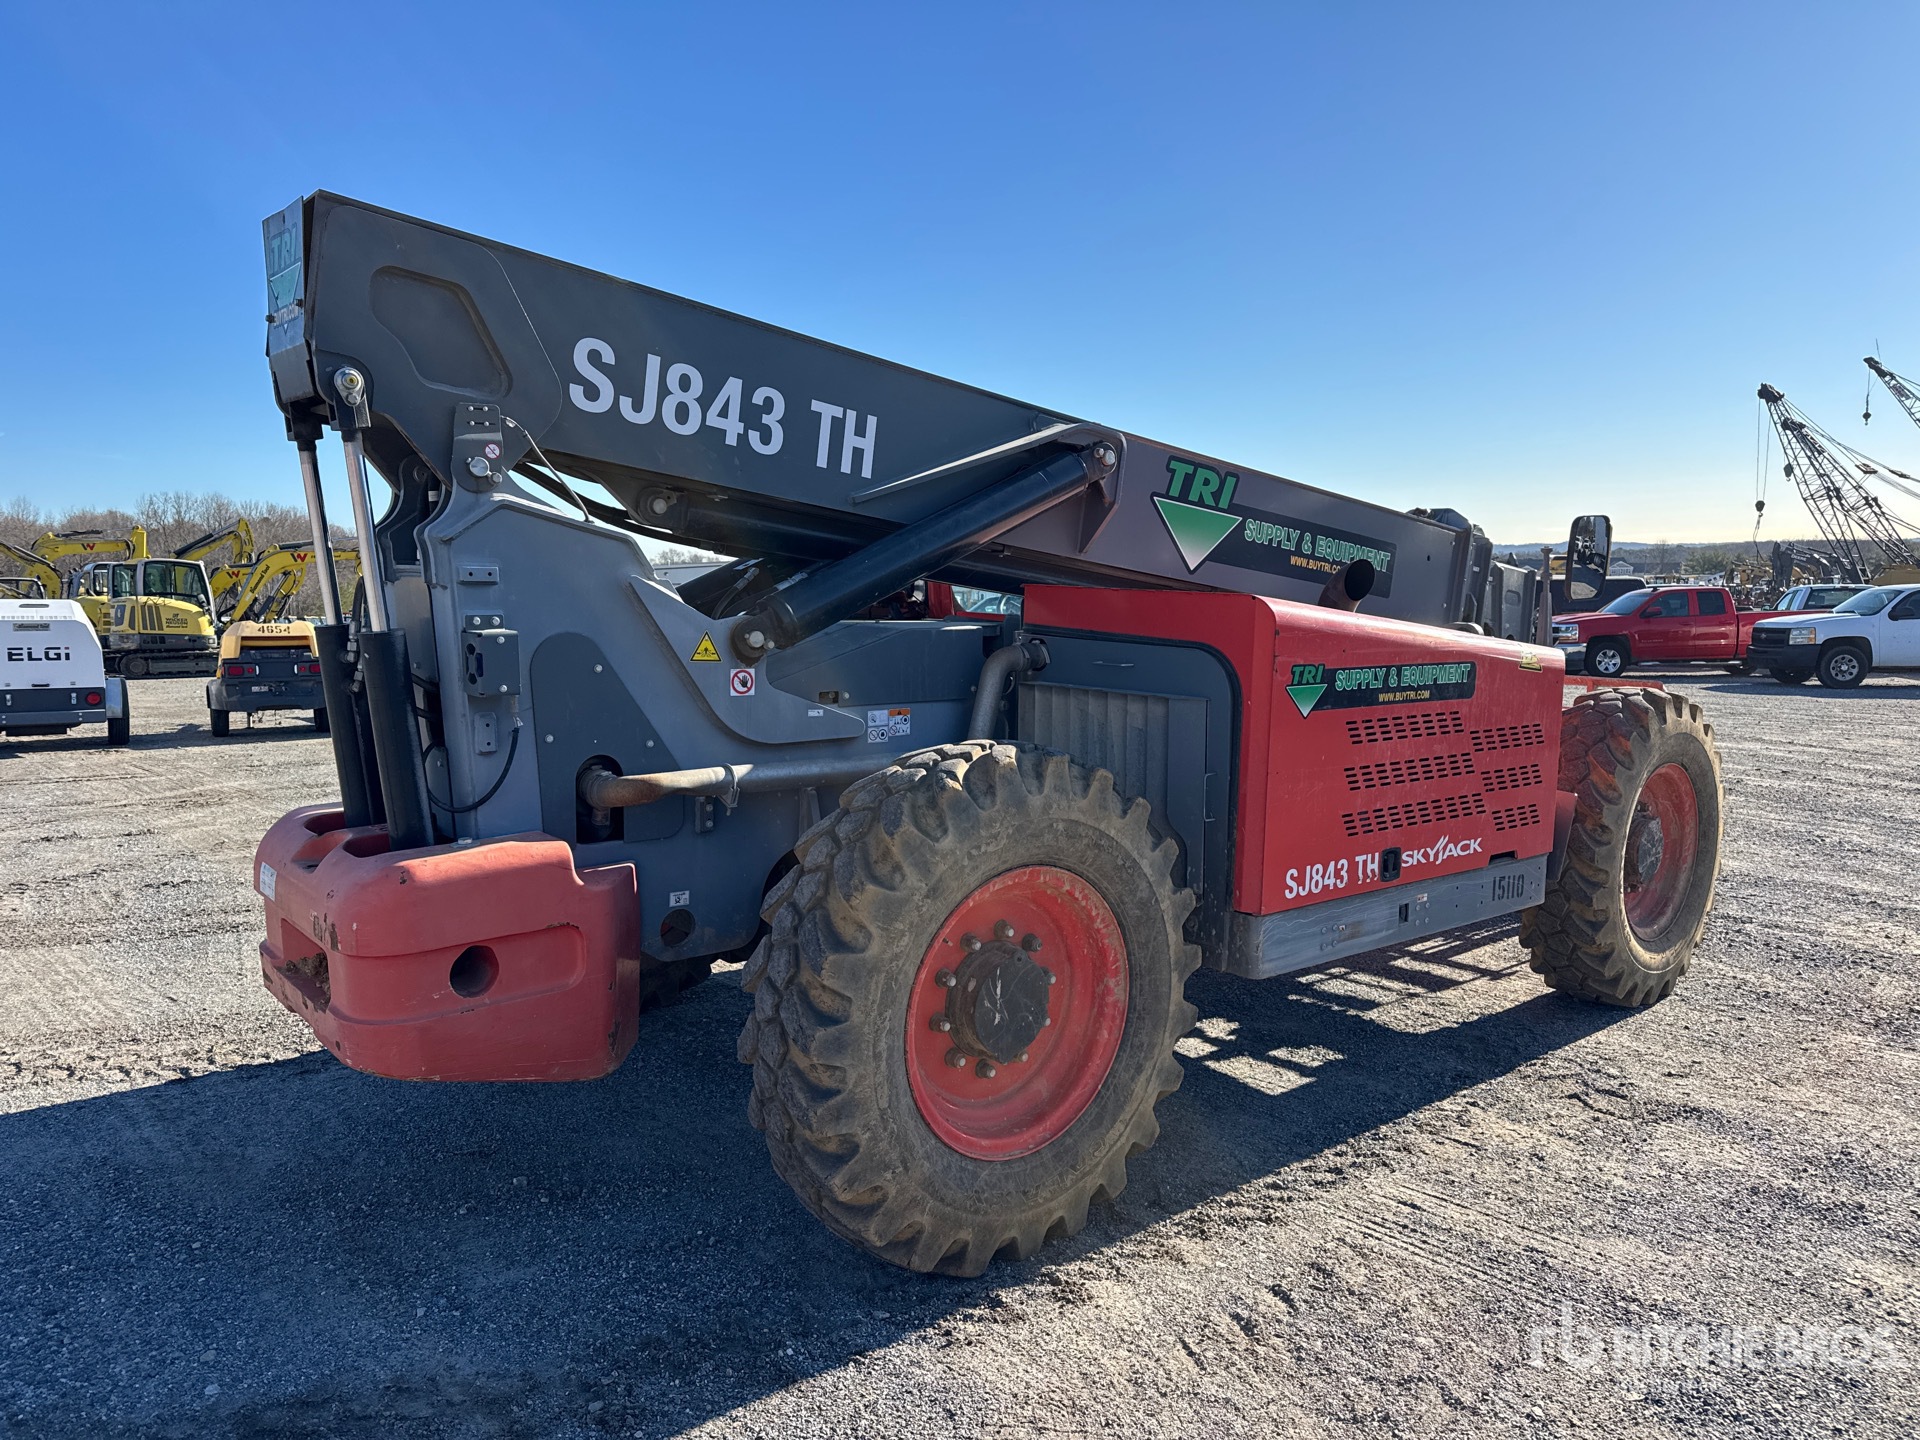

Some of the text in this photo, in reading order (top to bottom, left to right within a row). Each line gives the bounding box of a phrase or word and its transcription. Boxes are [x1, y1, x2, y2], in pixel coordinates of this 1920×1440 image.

[270, 225, 297, 272] TRI
[569, 337, 878, 479] SJ843 TH
[1168, 460, 1238, 510] TRI
[1244, 518, 1301, 552] SUPPLY
[1302, 533, 1313, 555] &
[1290, 555, 1342, 575] WWW.BUYTRI.CO
[257, 625, 291, 634] 4654
[1292, 665, 1324, 685] TRI
[1335, 663, 1471, 691] SUPPLY & EQUIPMENT
[1378, 690, 1430, 703] WWW.BUYTRI.COM
[1401, 835, 1483, 868] SKYJACK
[1284, 852, 1379, 900] SJ843 TH
